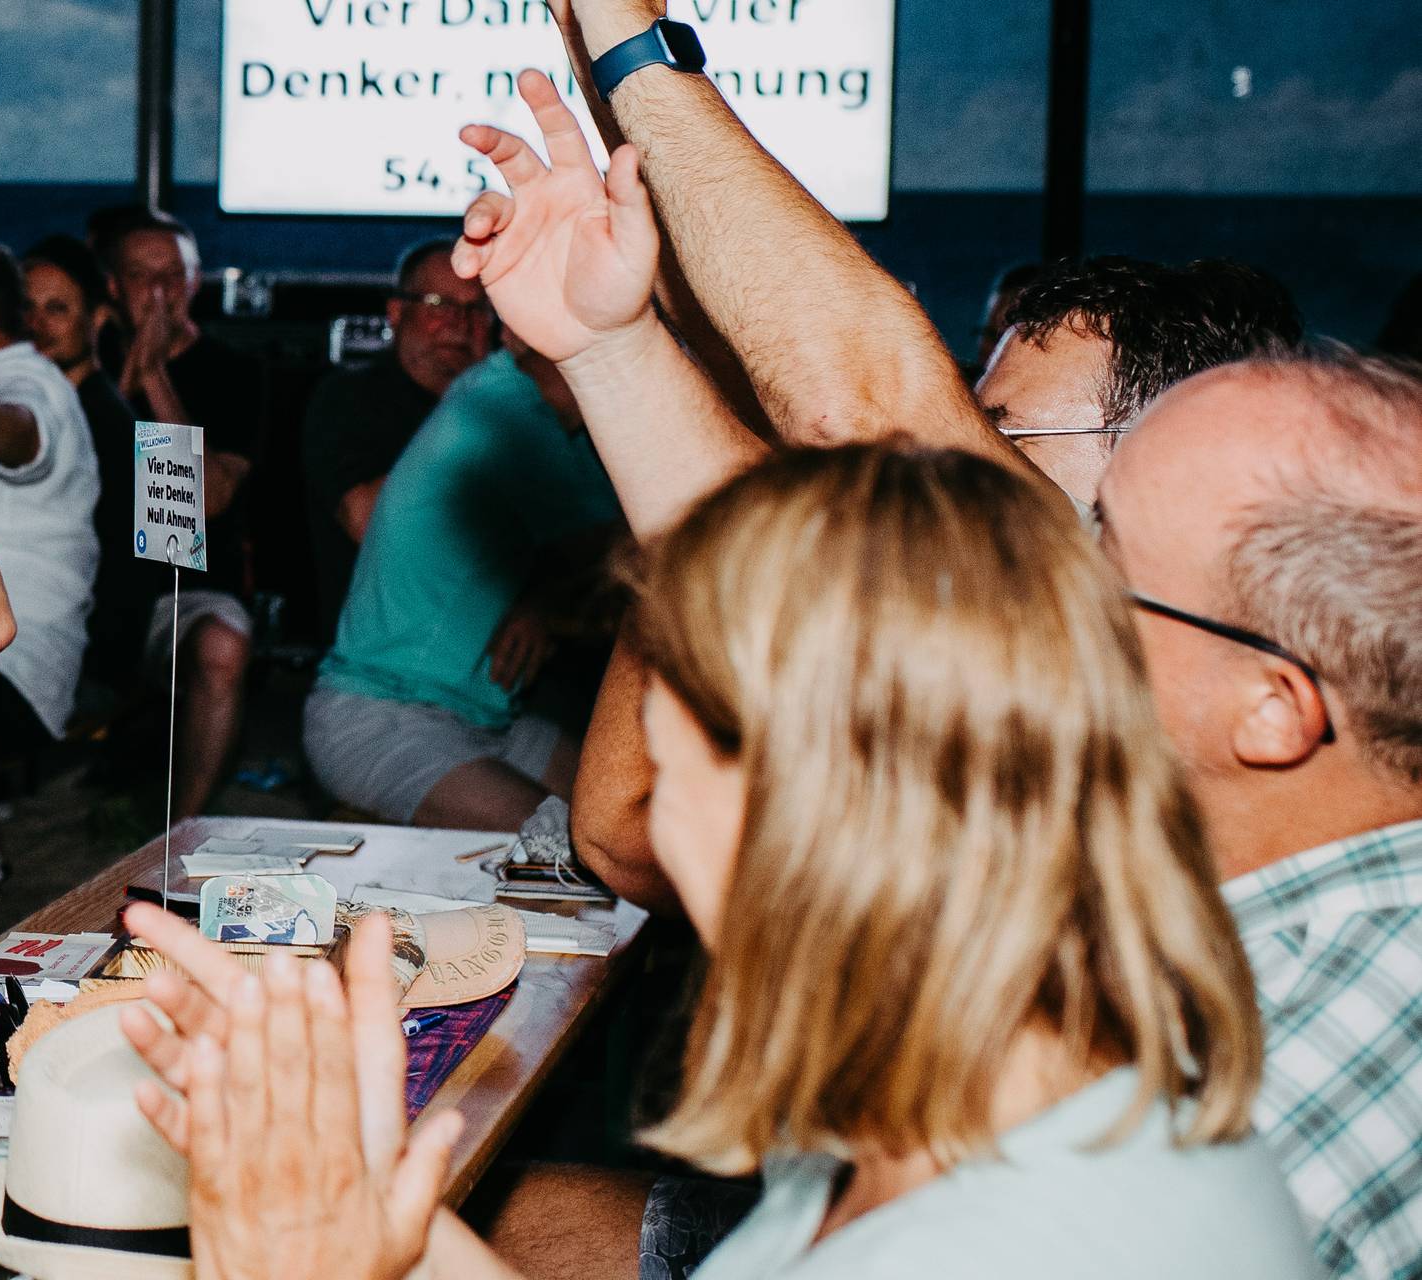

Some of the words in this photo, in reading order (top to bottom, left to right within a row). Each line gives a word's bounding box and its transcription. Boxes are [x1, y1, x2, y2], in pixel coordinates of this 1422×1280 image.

[304, 0, 413, 26] Vier
[714, 68, 870, 110] nung
[140, 435, 172, 449] WILLKOMMEN
[147, 456, 165, 475] Vier
[167, 460, 195, 483] Damen,
[147, 480, 164, 499] vier
[166, 484, 196, 508] Denker,
[147, 507, 165, 524] Null
[166, 510, 196, 534] Ahnung
